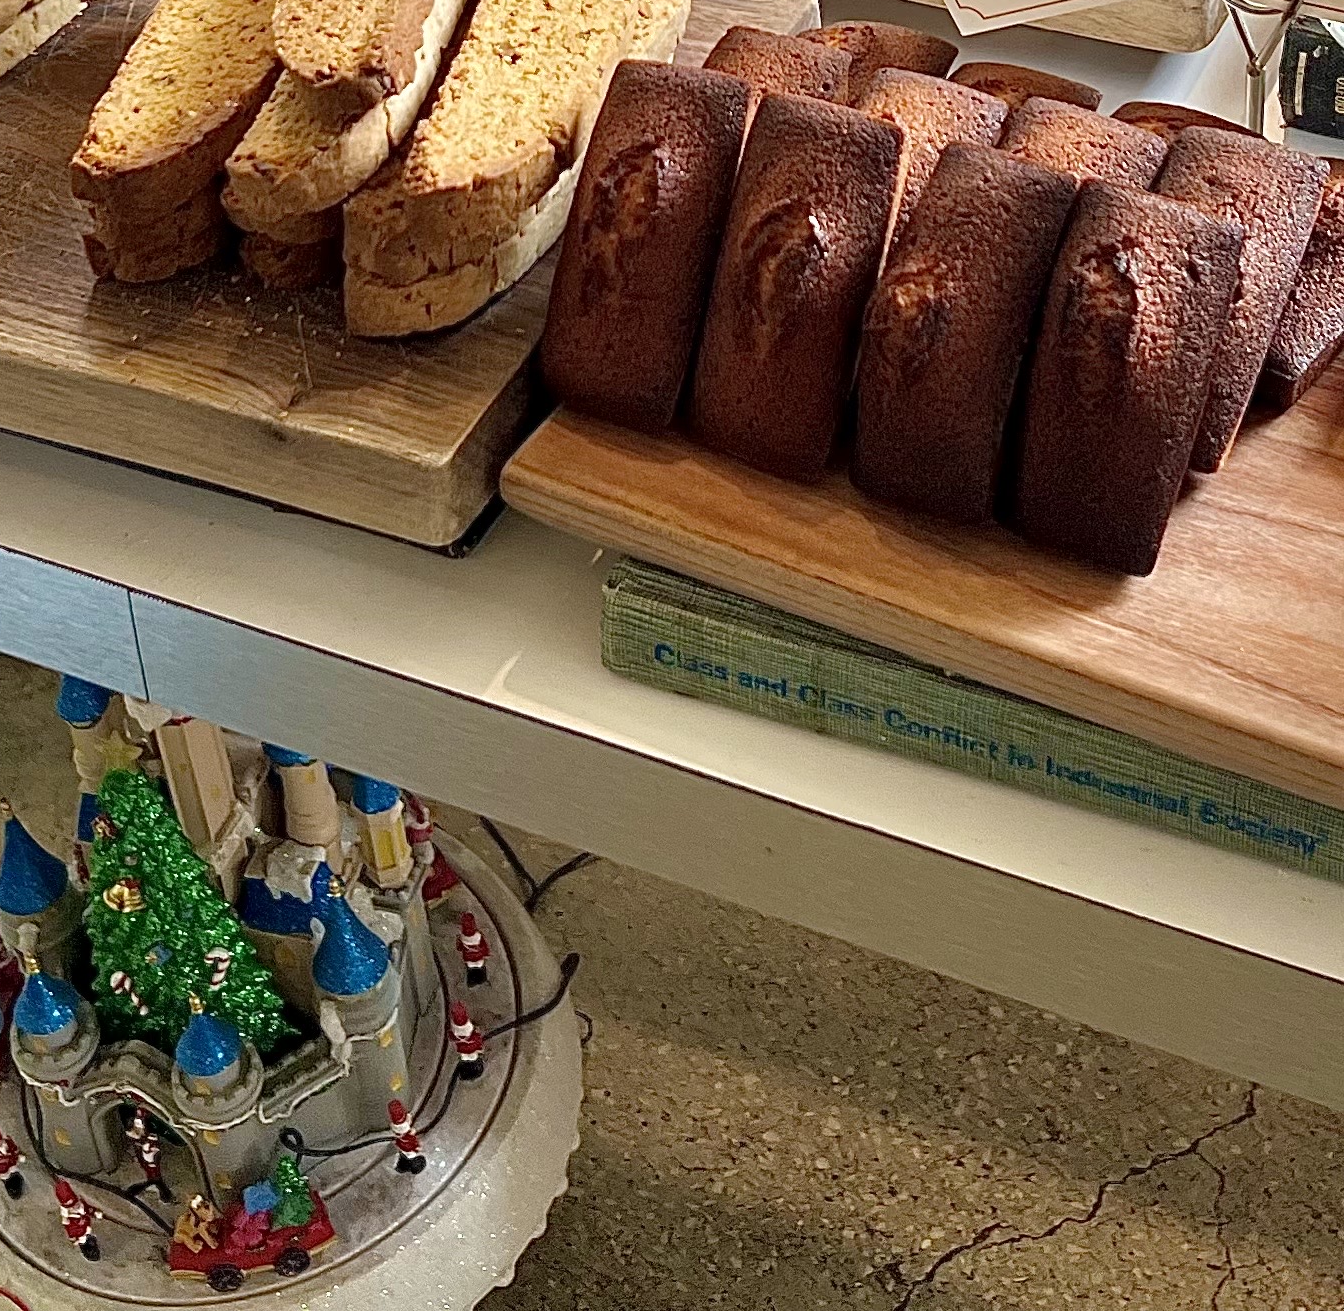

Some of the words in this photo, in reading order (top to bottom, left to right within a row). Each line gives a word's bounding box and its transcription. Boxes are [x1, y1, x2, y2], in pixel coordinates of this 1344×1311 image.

[654, 643, 729, 681] Class
[738, 670, 788, 699] and
[798, 683, 874, 722] Class
[883, 708, 998, 756] Conflict
[1007, 744, 1035, 771] in
[1046, 756, 1189, 814] Industrial
[1199, 798, 1323, 857] Society
